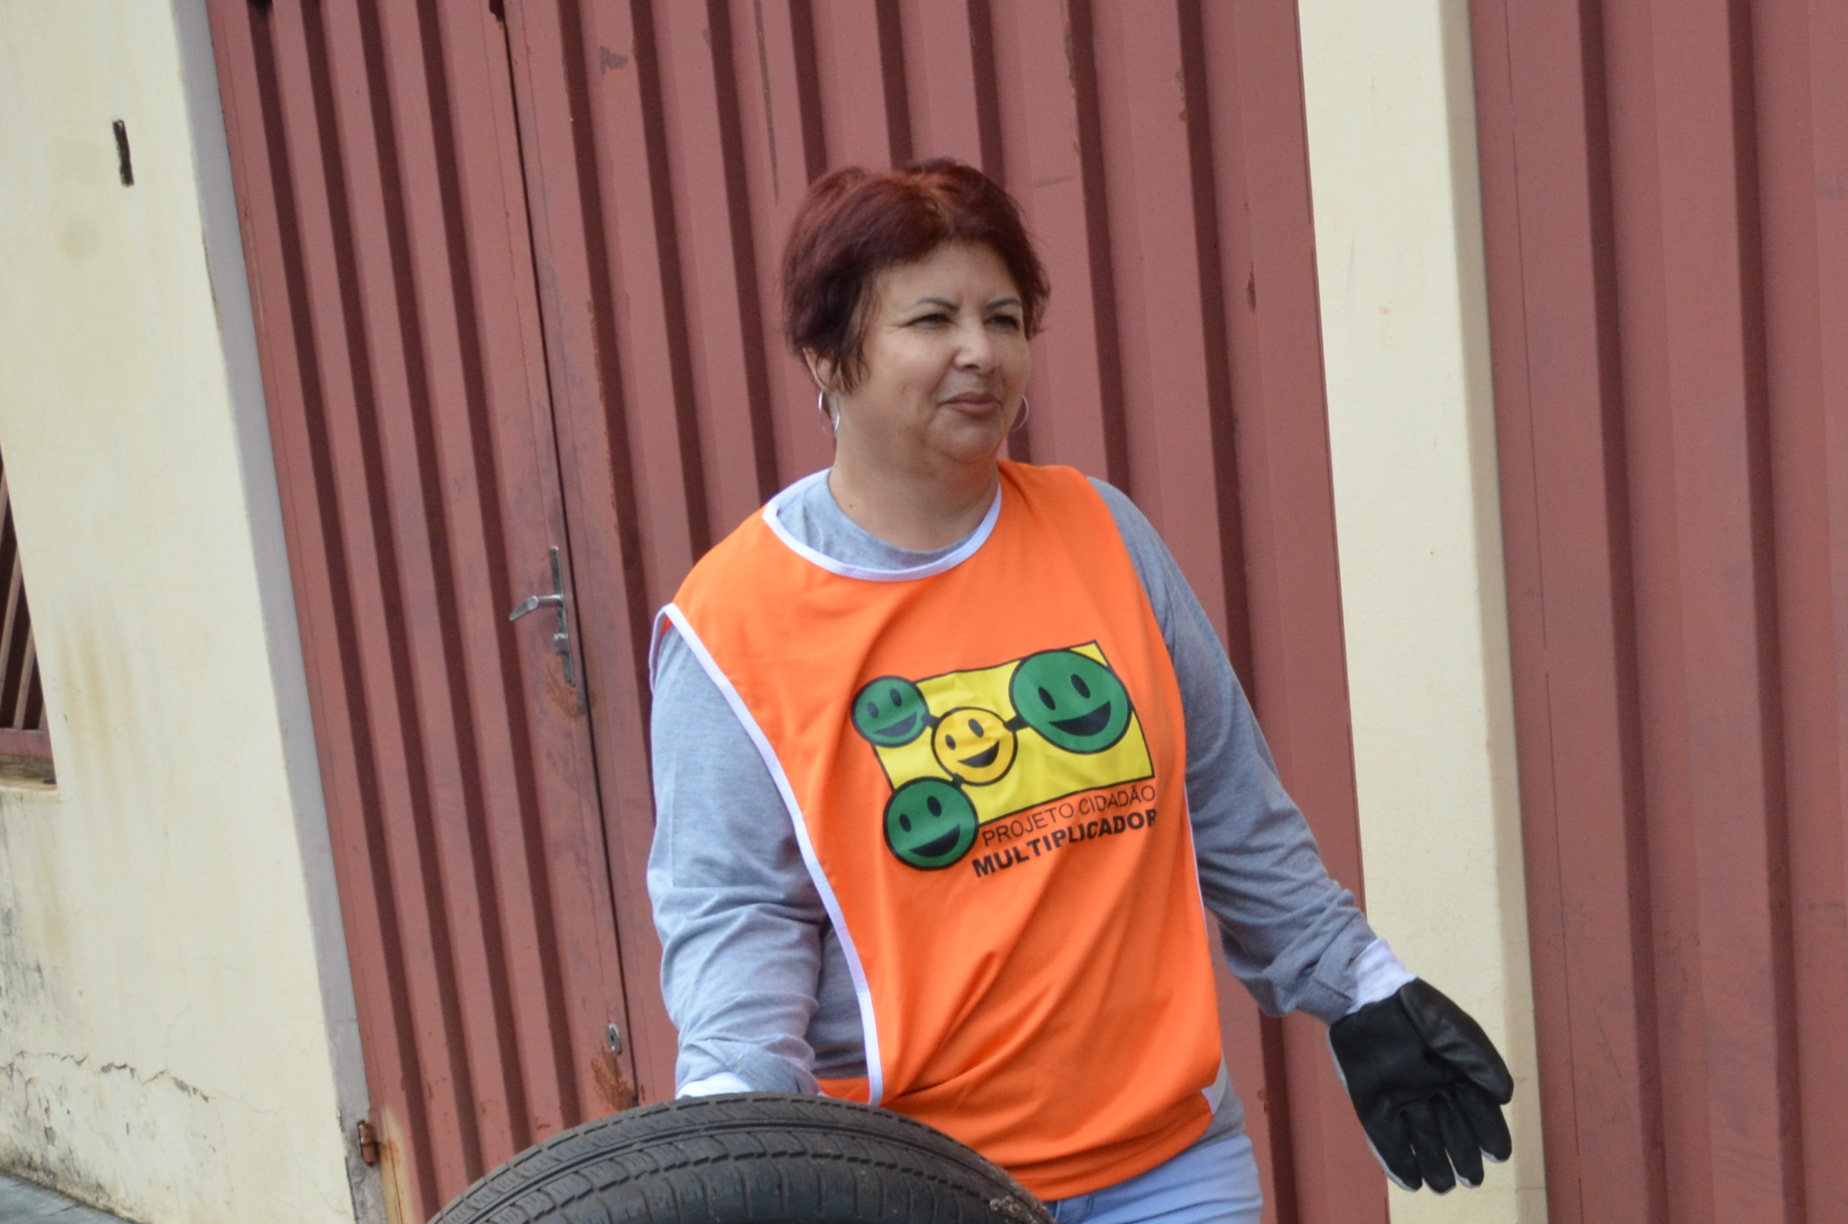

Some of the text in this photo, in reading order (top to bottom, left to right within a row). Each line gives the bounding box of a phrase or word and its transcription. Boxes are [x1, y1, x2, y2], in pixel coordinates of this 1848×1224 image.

[971, 808, 1157, 878] MULTIPLICADOR
[982, 785, 1156, 846] PROJETO CIDADÃO
